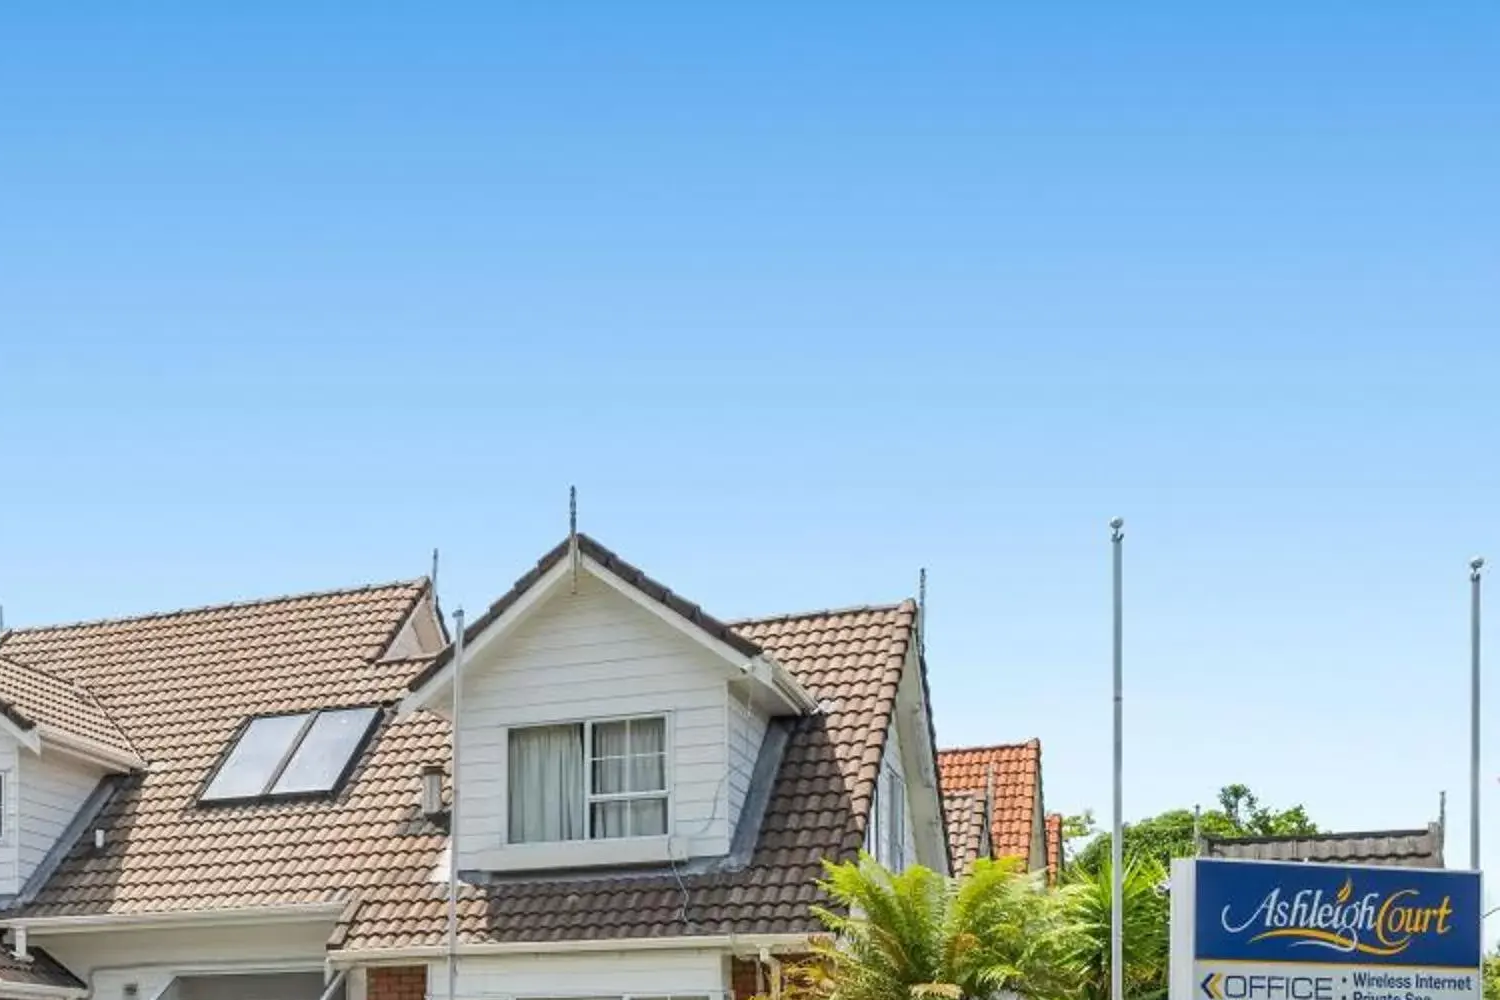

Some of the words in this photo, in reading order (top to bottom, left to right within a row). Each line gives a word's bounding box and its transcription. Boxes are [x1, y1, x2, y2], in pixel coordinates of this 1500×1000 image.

[1376, 889, 1452, 946] Court
[1224, 974, 1333, 1000] OFFICE
[1352, 972, 1411, 990] Wireless
[1414, 974, 1472, 991] Internet
